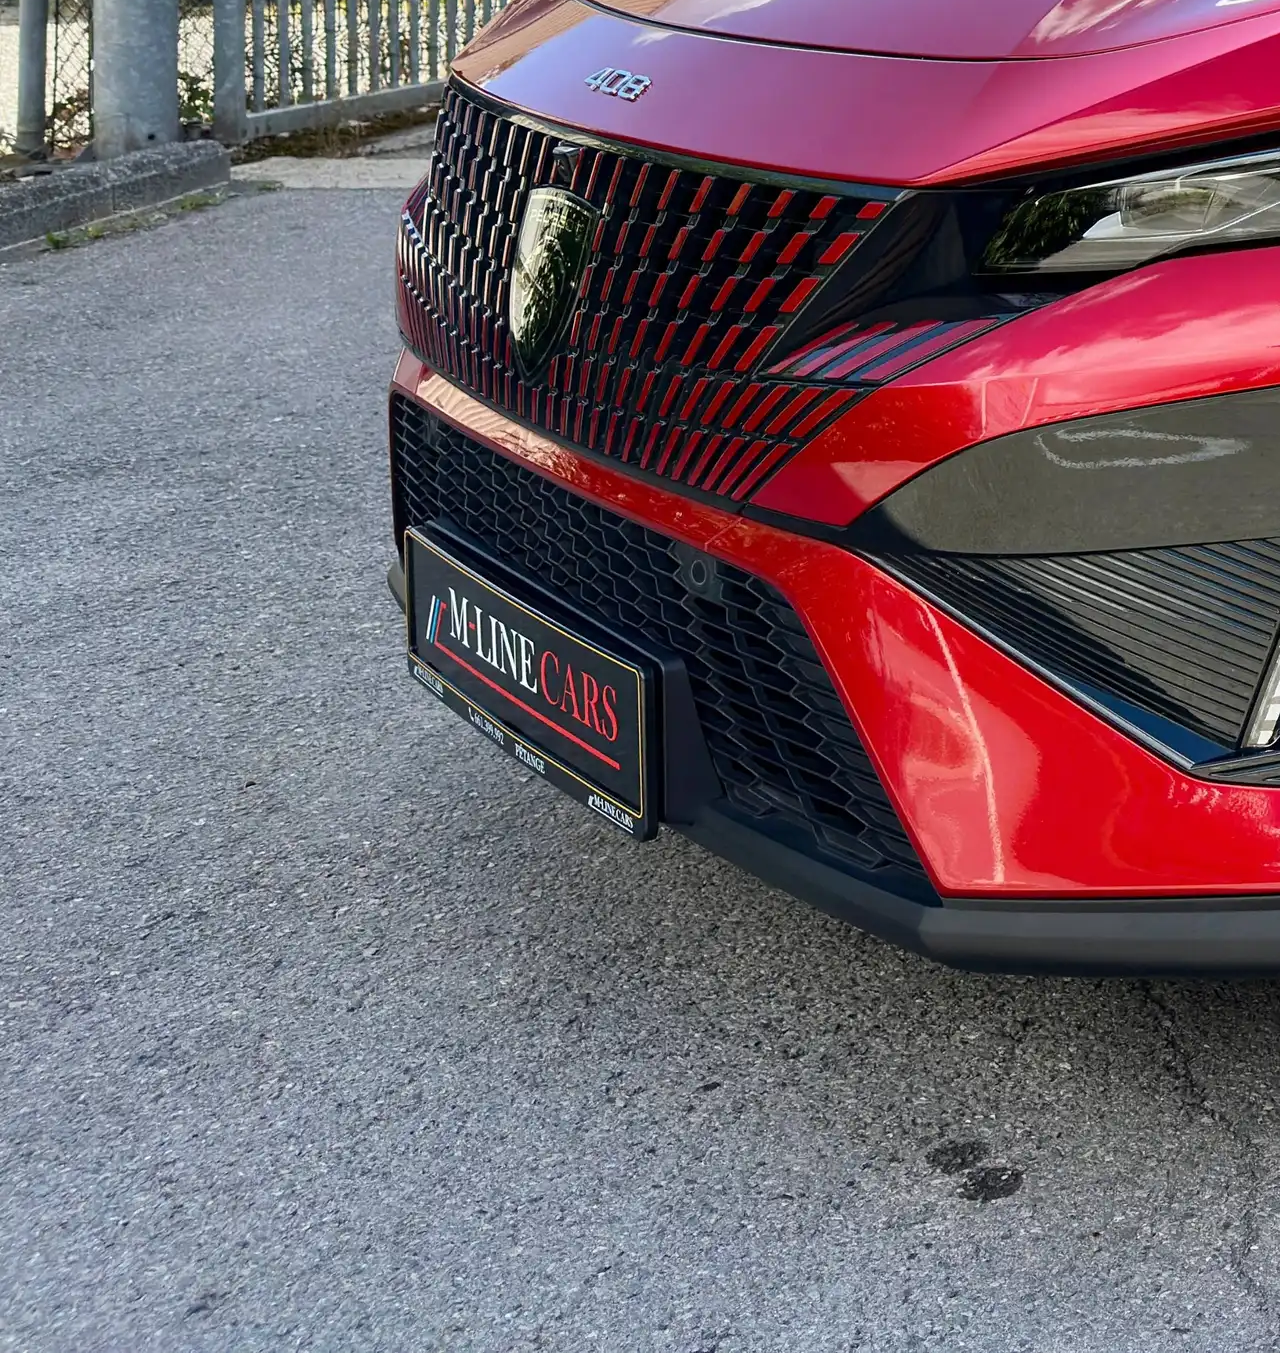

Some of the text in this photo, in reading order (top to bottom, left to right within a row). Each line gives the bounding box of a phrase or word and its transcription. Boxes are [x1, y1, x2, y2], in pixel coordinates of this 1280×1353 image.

[583, 67, 654, 103] 408
[448, 587, 619, 742] M-LINE CARS
